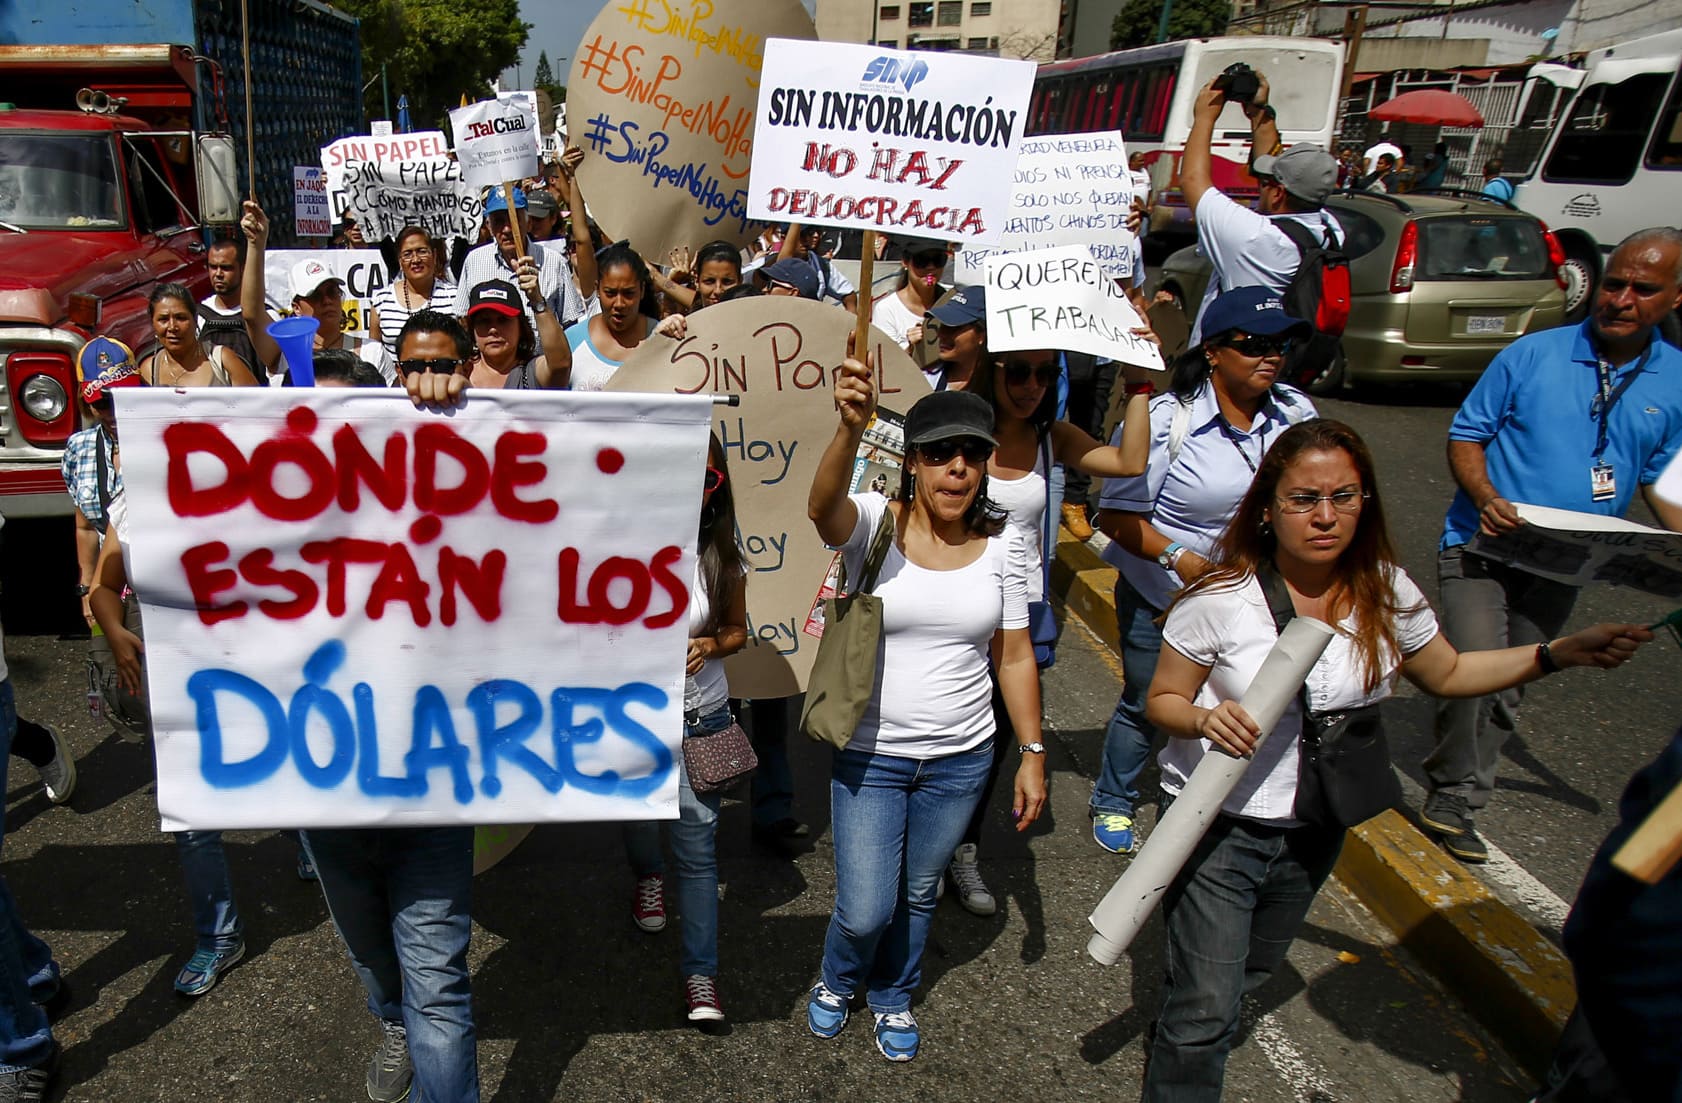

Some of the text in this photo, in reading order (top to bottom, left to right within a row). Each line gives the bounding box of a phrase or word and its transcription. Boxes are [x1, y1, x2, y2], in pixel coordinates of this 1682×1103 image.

[768, 88, 1017, 149] SIN INFORMACIÓN
[329, 137, 447, 167] SIN PAPEL
[345, 159, 384, 184] SIN
[801, 142, 966, 190] NO HAY
[1012, 163, 1127, 183] DIOS NI PRENSA
[413, 192, 482, 217] MANTENGO
[766, 187, 988, 236] DEMOCRACIA
[1014, 192, 1049, 208] SOLO
[1054, 191, 1083, 206] NOS
[364, 216, 376, 236] A
[1060, 214, 1107, 229] CHINOS
[163, 404, 561, 523] DÓNDE
[719, 416, 798, 486] Hay
[181, 514, 690, 630] ESTÁN LOS
[185, 638, 675, 806] DÓLARES
